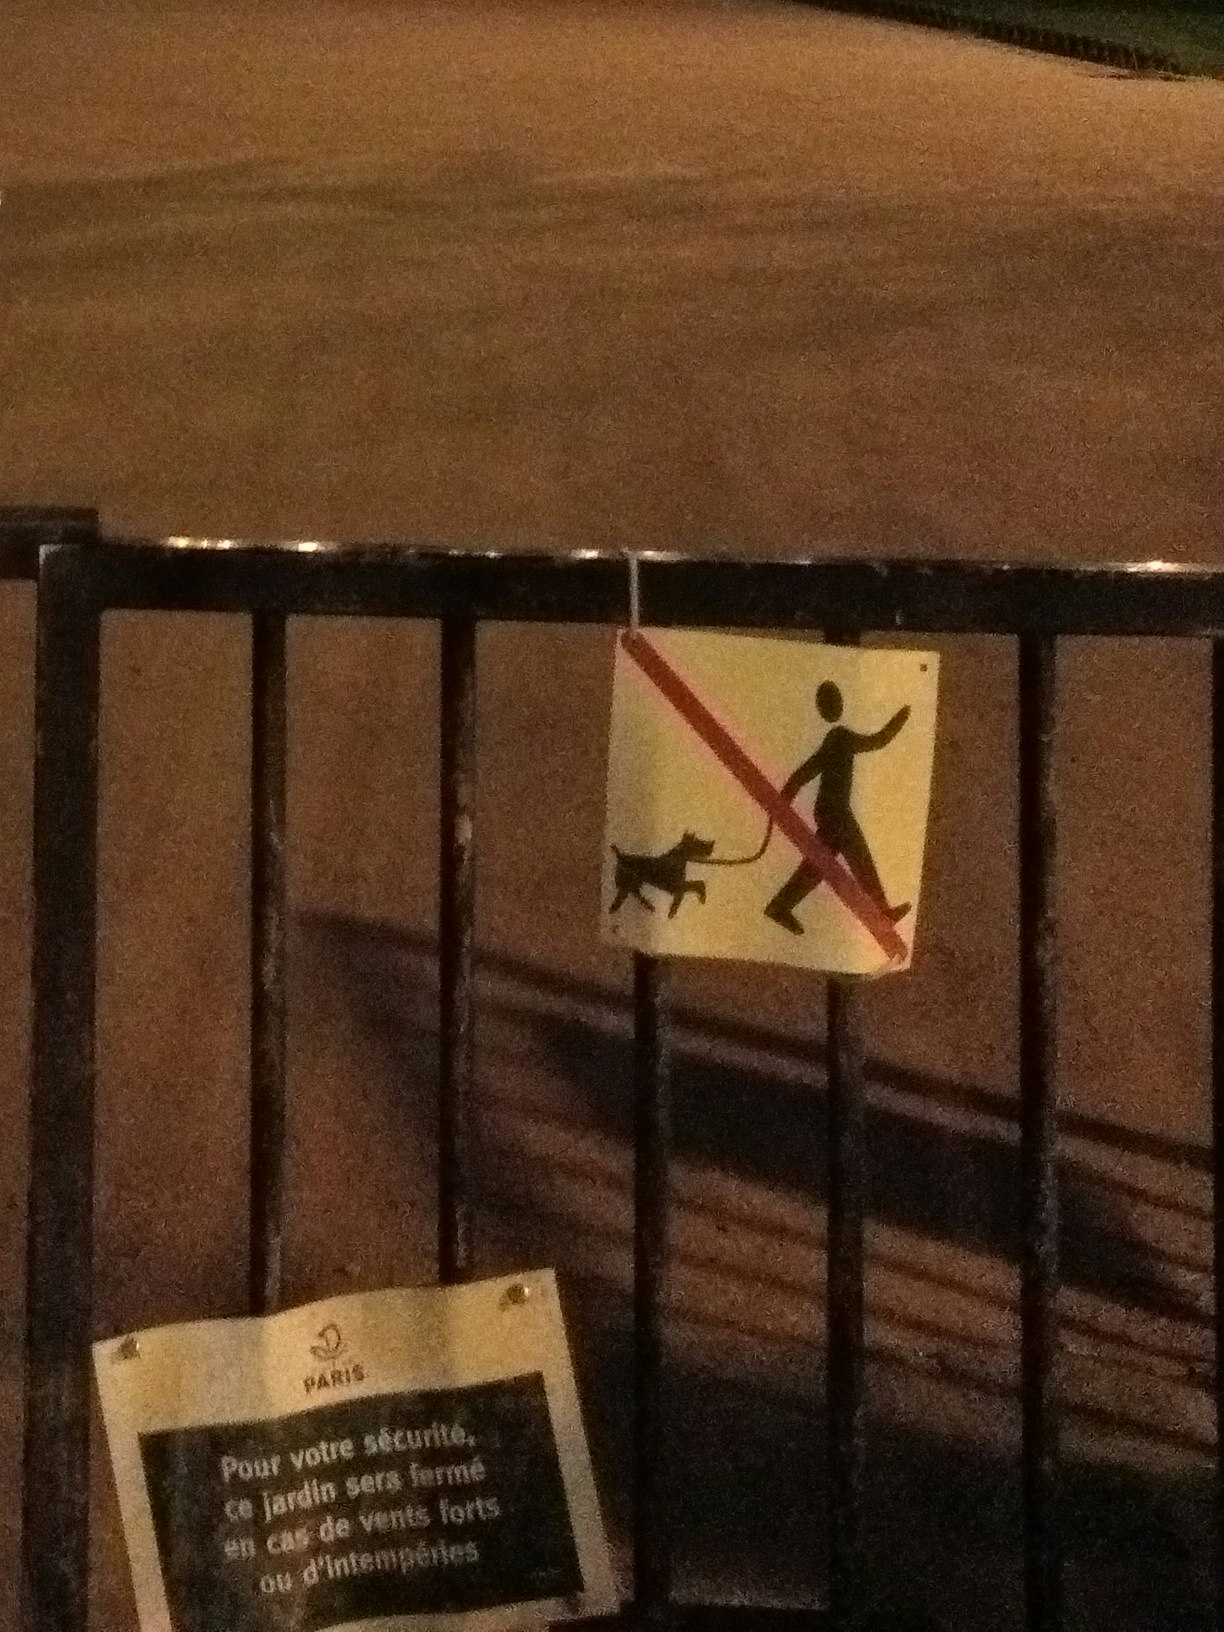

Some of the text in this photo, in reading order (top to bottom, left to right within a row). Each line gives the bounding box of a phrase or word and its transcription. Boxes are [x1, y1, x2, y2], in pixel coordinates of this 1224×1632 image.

[303, 1364, 365, 1394] PARIS
[219, 1421, 477, 1483] Pour votre sécurité,
[224, 1455, 487, 1524] ce jardin sera fermé
[223, 1496, 501, 1562] en cas de vents forts
[259, 1539, 480, 1596] ou d'intempéries
